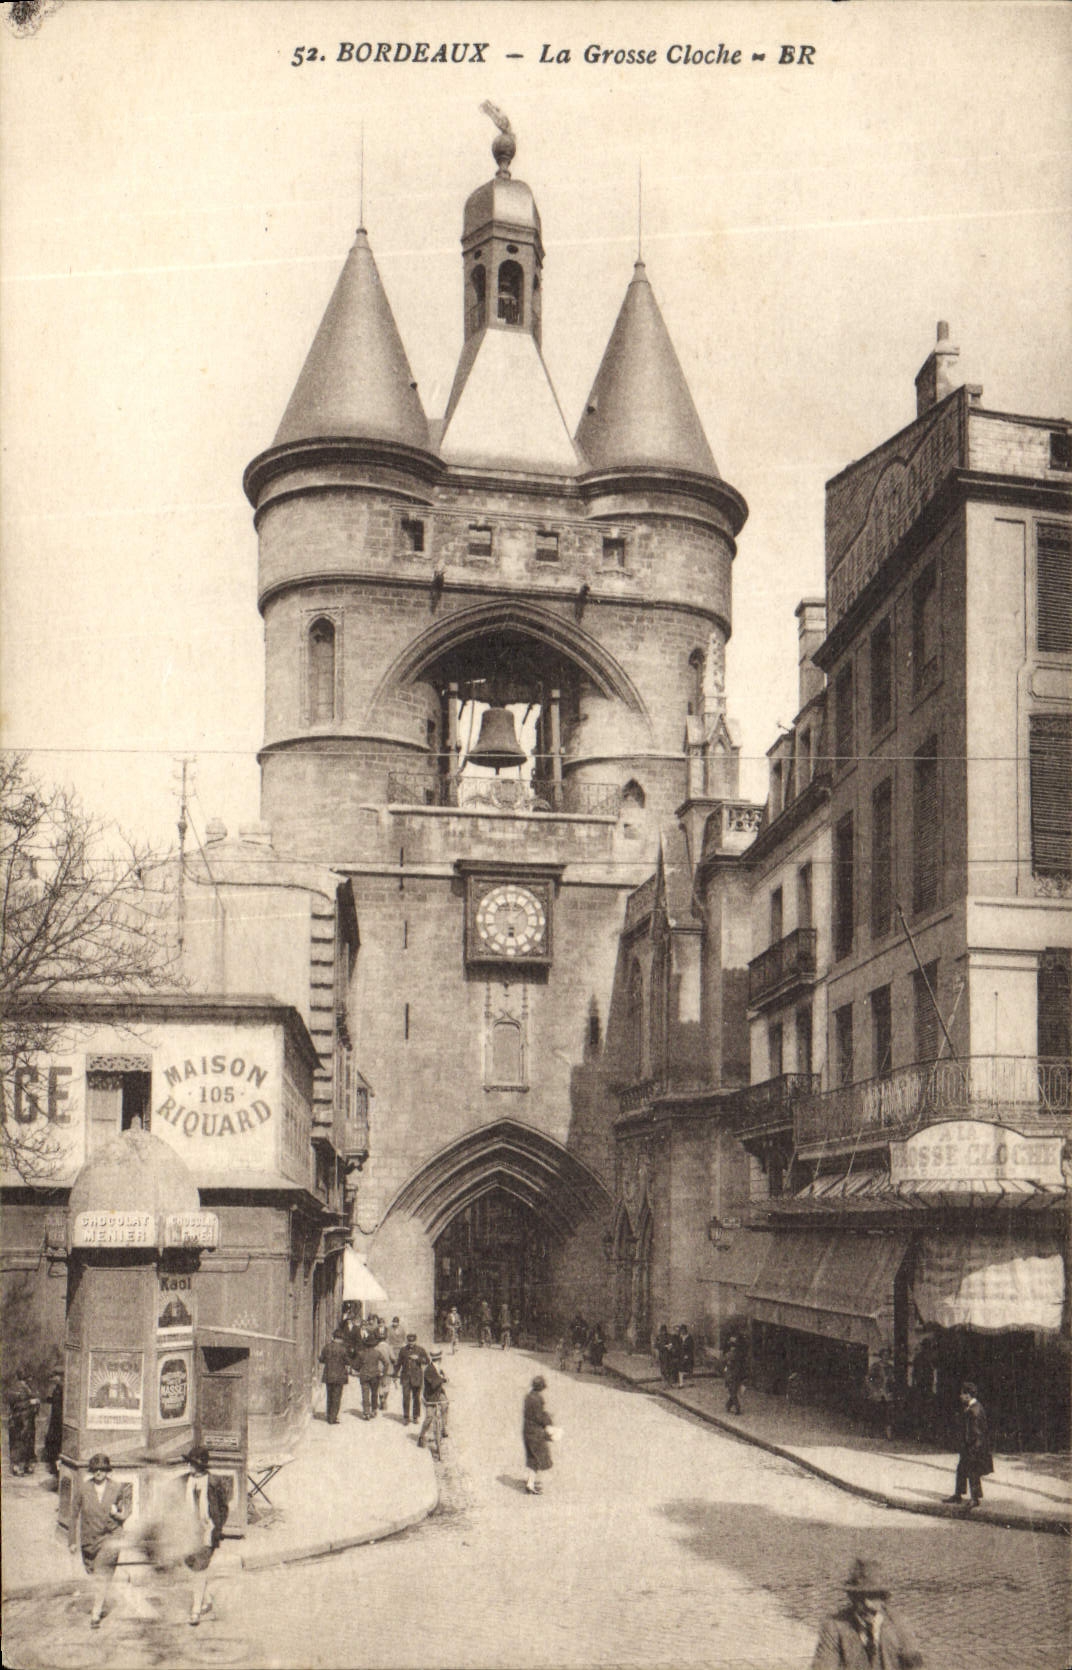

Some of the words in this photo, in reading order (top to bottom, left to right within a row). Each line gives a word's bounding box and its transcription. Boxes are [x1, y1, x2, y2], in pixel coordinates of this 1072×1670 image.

[163, 1055, 269, 1088] MAISON
[0, 1066, 73, 1124] GE
[200, 1086, 235, 1103] 105
[155, 1095, 272, 1137] RIQUARD
[82, 1215, 150, 1227] CHOCOLAT
[83, 1229, 147, 1243] MENIER
